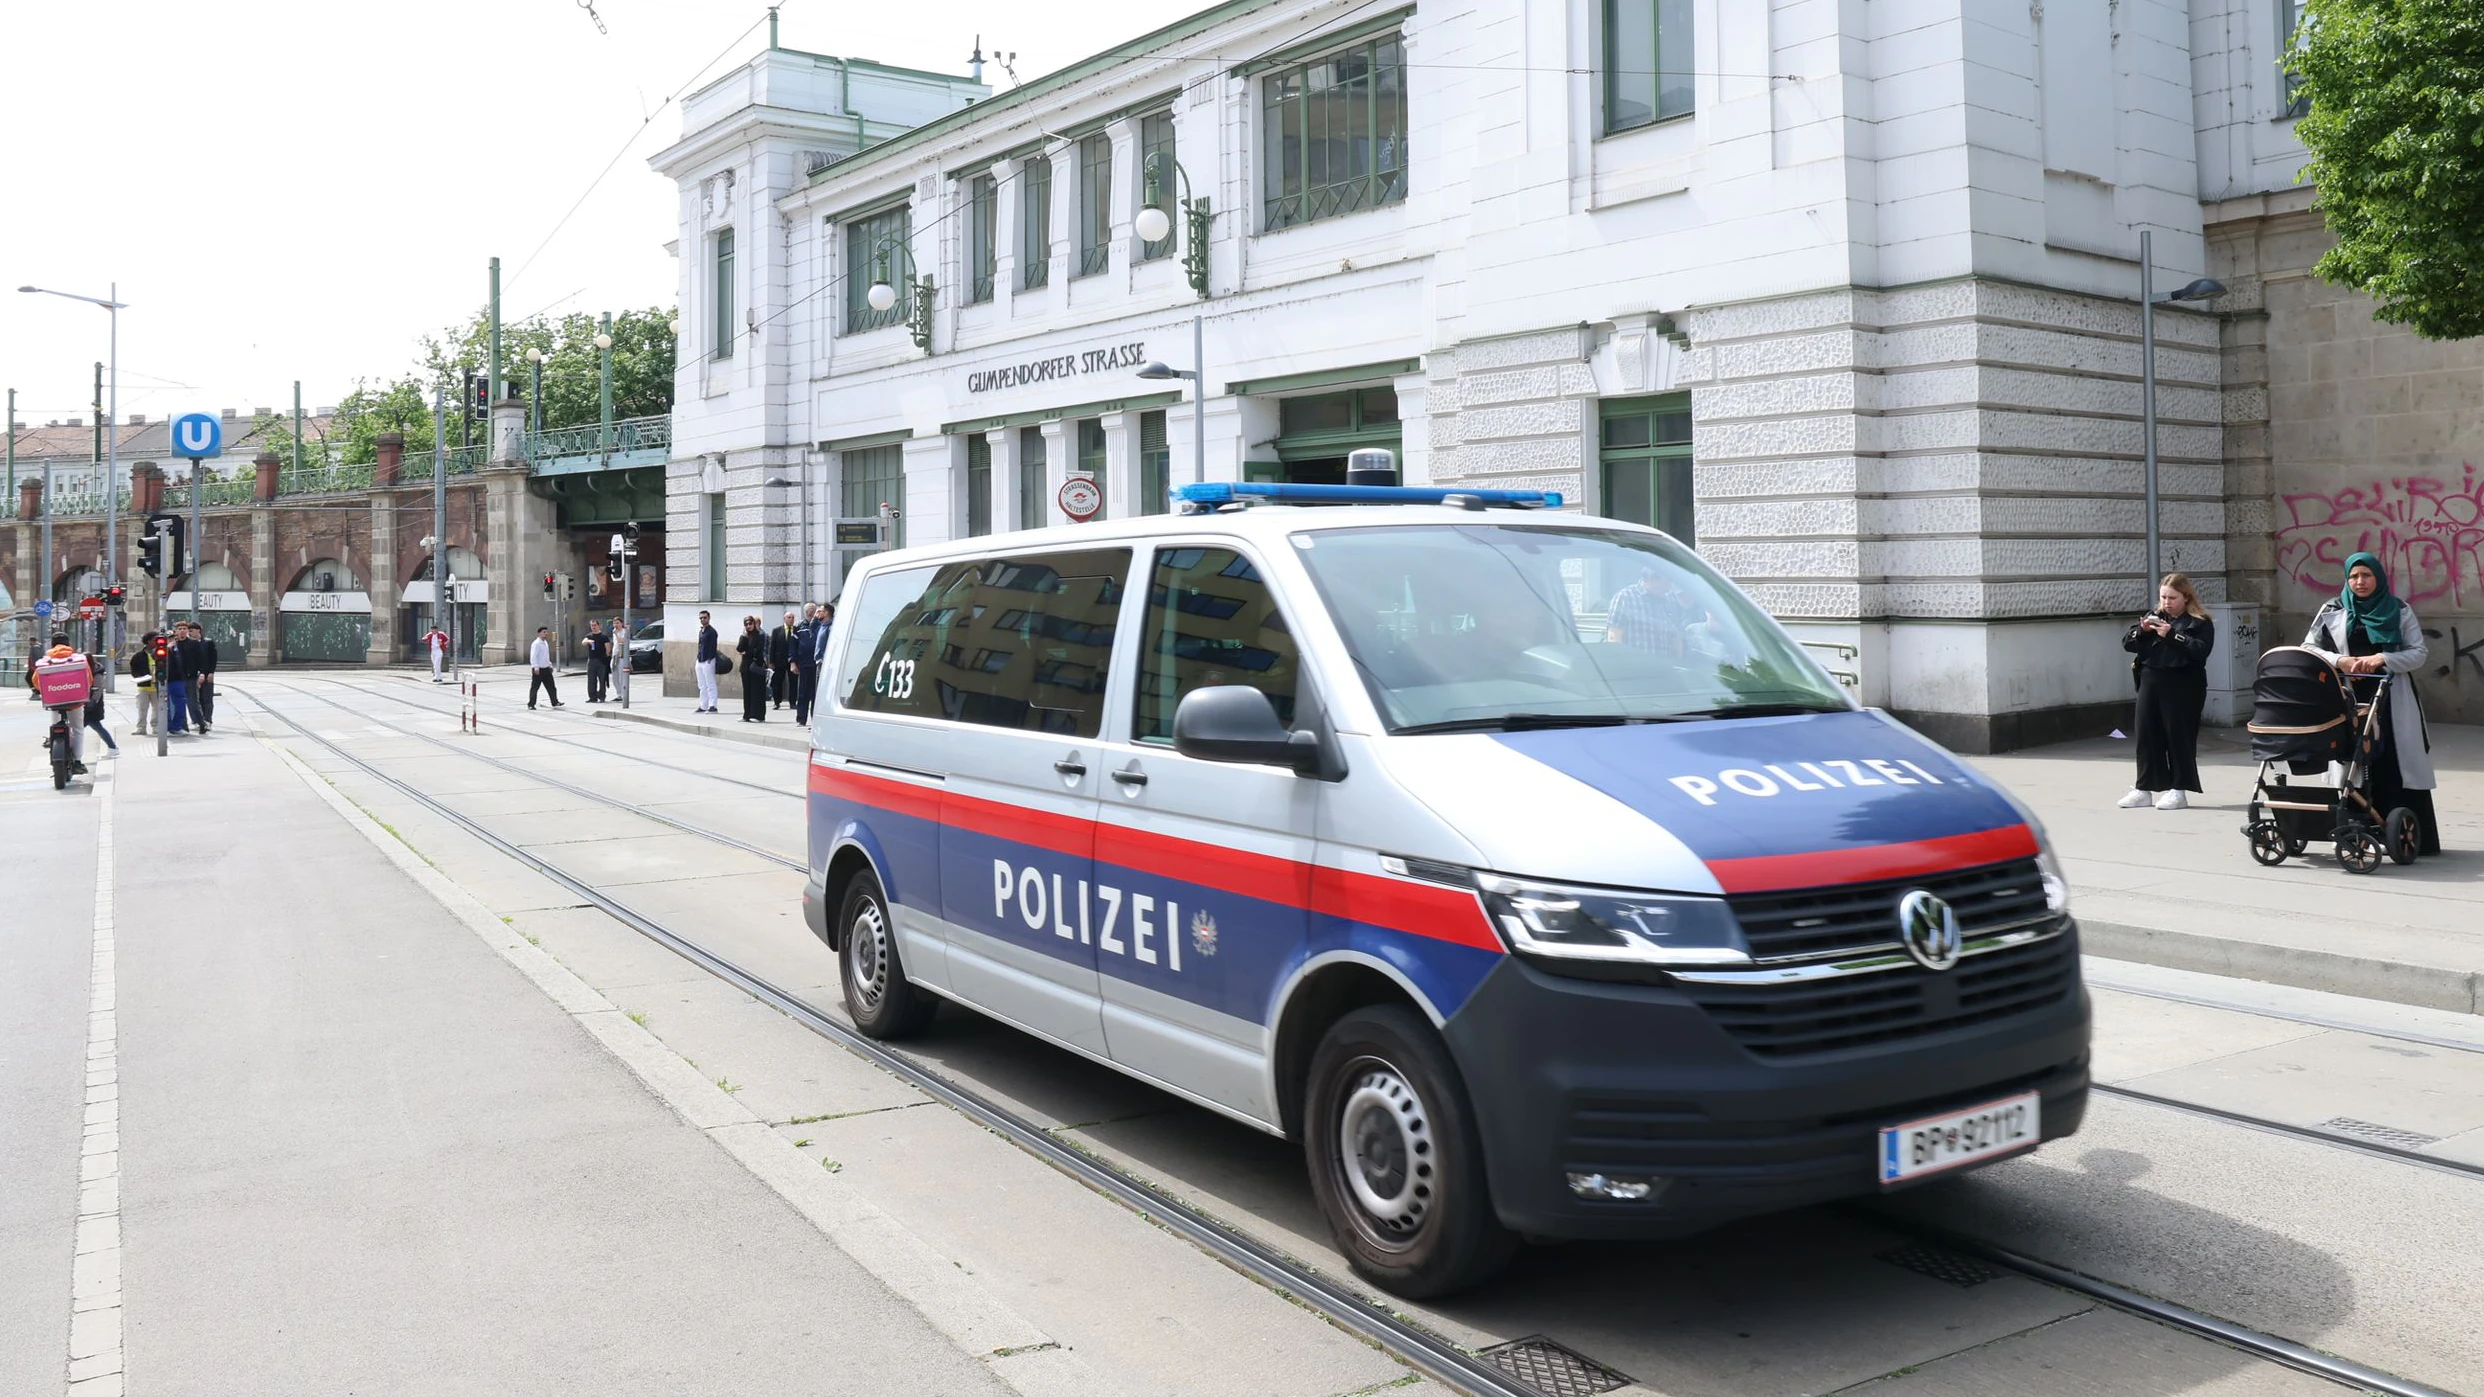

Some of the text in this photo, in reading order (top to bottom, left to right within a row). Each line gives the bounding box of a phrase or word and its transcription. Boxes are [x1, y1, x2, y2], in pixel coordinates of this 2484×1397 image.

[968, 342, 1147, 393] GUMPENDORFER STRASSE
[182, 421, 211, 451] U
[199, 594, 223, 609] EAUTY
[311, 594, 341, 609] BEAUTY
[48, 682, 81, 692] foodora
[888, 659, 915, 699] 133
[1668, 759, 1944, 806] POLIZEI
[994, 858, 1181, 972] POLIZEI
